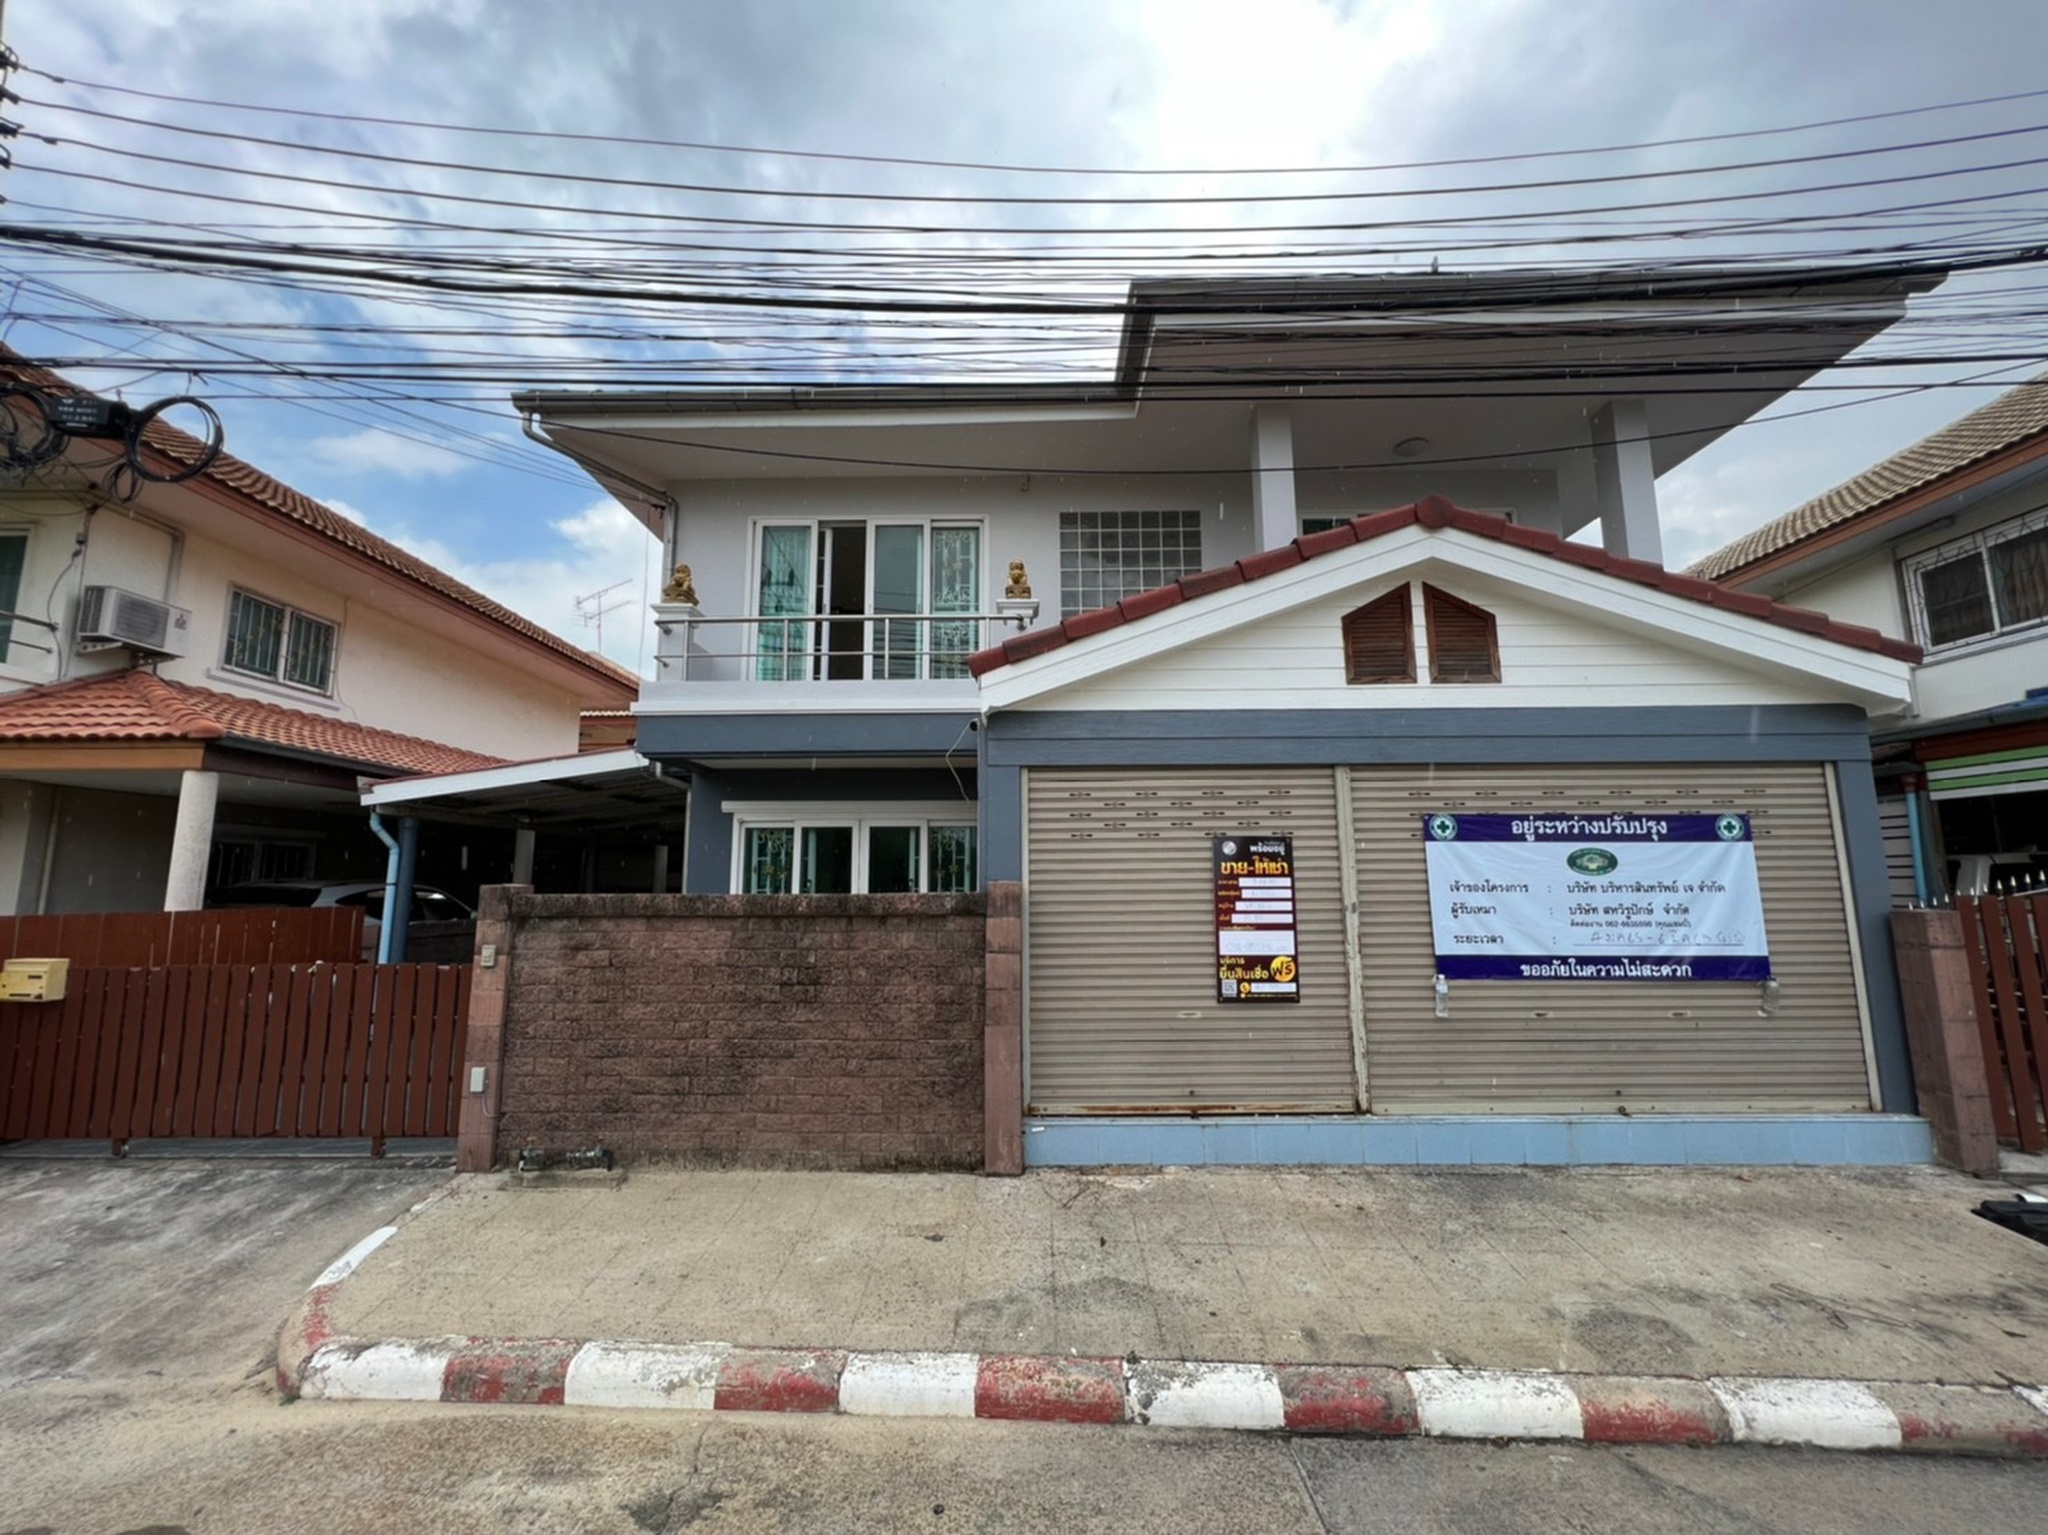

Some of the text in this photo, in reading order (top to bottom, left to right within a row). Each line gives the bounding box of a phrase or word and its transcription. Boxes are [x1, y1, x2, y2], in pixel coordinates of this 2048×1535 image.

[1511, 815, 1668, 842] อยู่ระหว่างปรับปรุง
[1220, 855, 1289, 875] ขาย-ให้เช่า
[1520, 957, 1693, 977] ขออภัยในความไม่สะดวก
